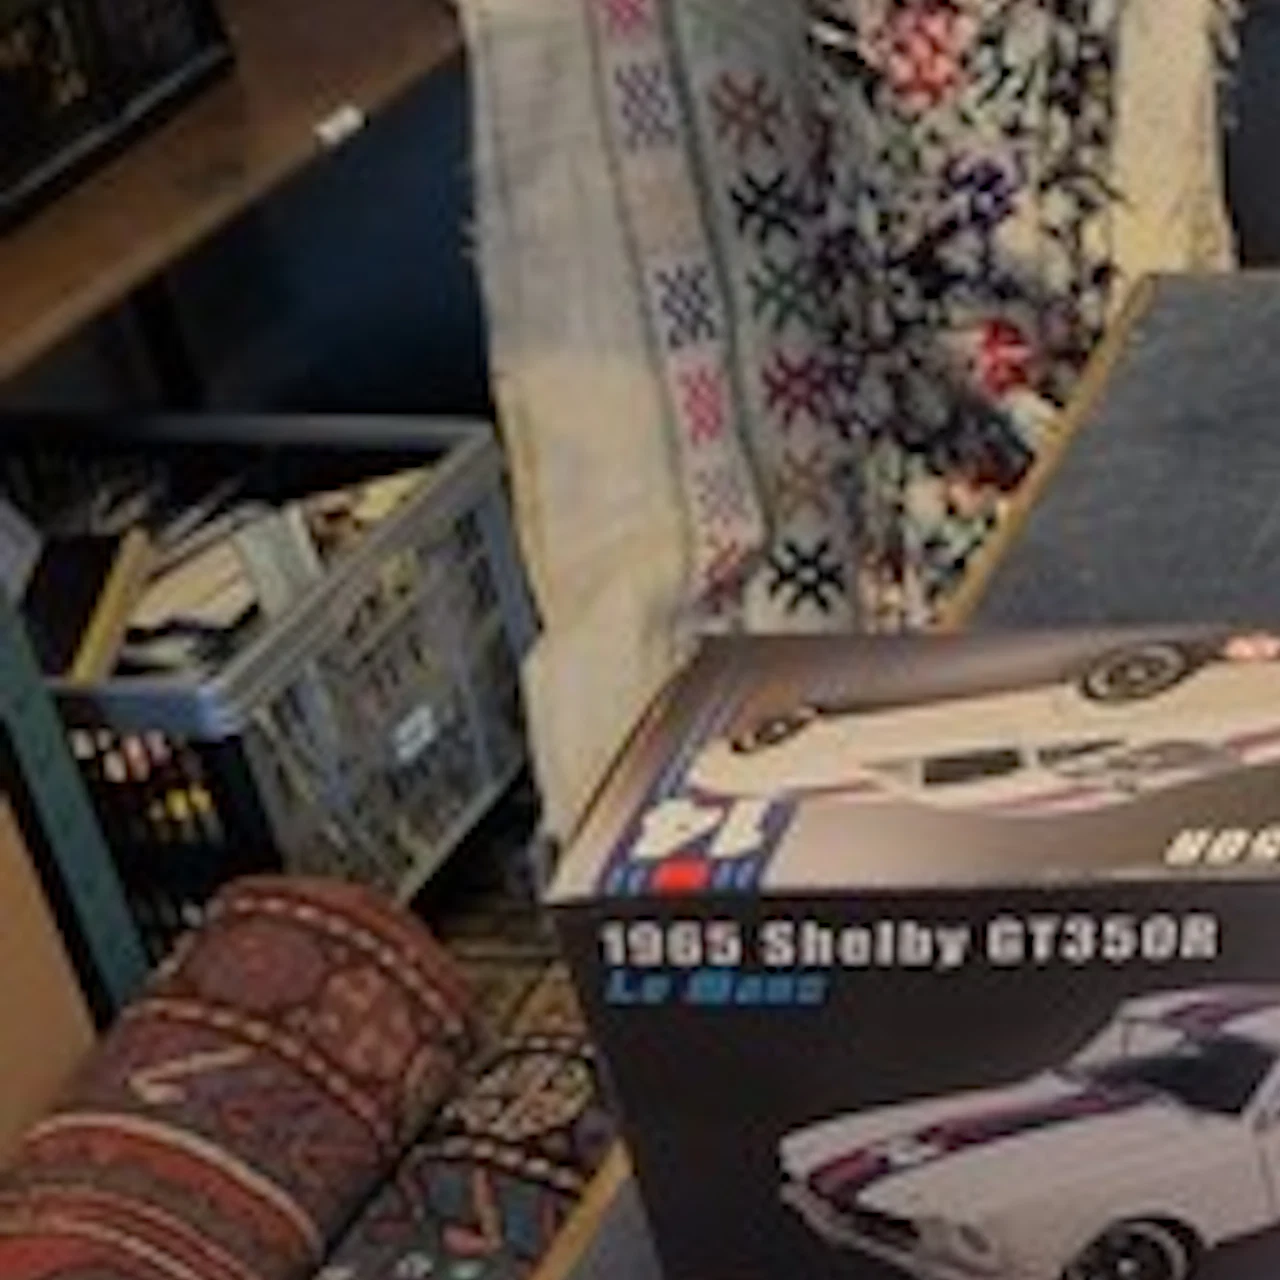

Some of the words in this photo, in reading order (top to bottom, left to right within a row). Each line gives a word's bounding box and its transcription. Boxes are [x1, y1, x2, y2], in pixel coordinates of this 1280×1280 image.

[600, 920, 742, 966] 1965
[760, 920, 970, 972] Shelby
[985, 913, 1219, 962] GT350R
